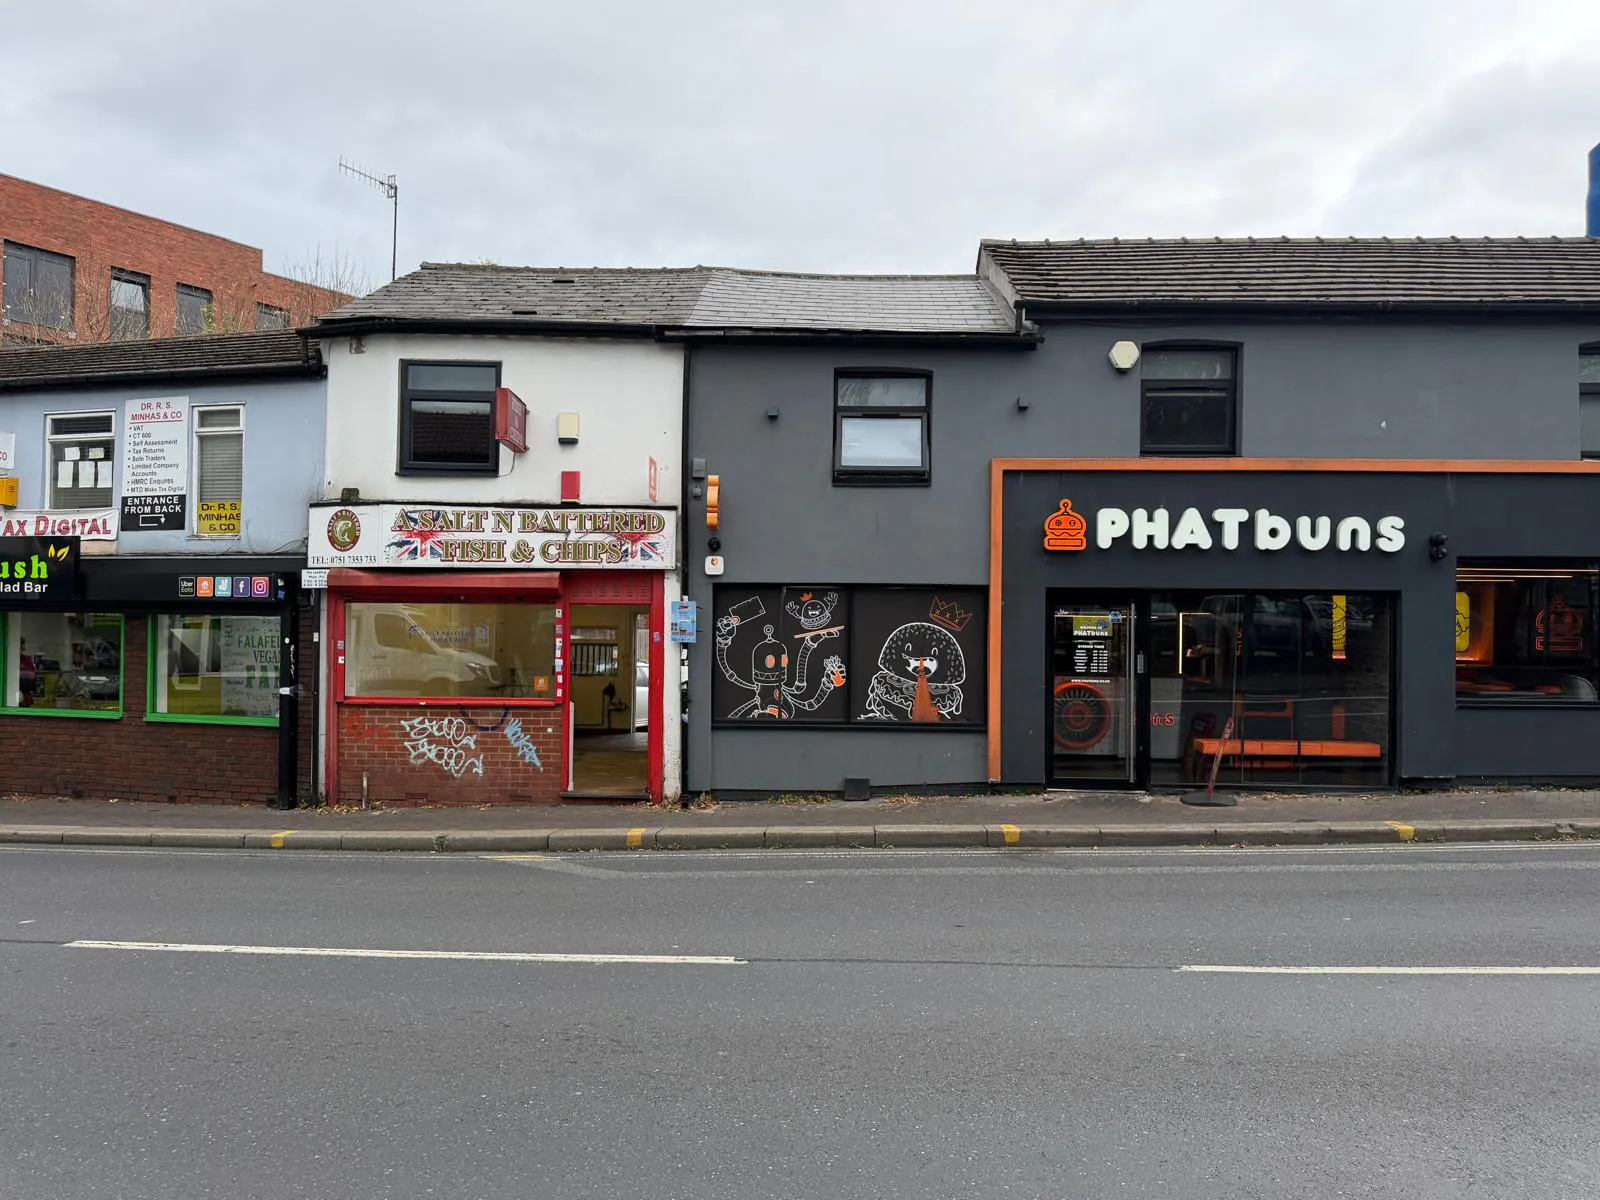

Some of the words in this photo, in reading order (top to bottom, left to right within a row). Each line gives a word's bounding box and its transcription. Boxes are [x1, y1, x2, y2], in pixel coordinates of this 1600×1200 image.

[131, 412, 160, 420] MINHAS
[128, 496, 179, 505] ENTRANCE
[125, 506, 151, 514] FROM
[155, 505, 182, 513] BACK
[199, 513, 241, 521] MINHAS
[392, 509, 414, 531] A
[418, 510, 488, 532] SALT
[492, 511, 516, 532] N
[518, 511, 665, 534] BATTERED
[0, 516, 27, 535] AX
[34, 516, 111, 536] DIGITAL
[440, 539, 506, 562] FISH
[510, 541, 535, 562] &
[541, 540, 624, 563] CHIPS
[311, 556, 328, 564] TEL:
[330, 556, 345, 564] 0751
[365, 556, 376, 564] 733
[24, 581, 48, 593] Bar
